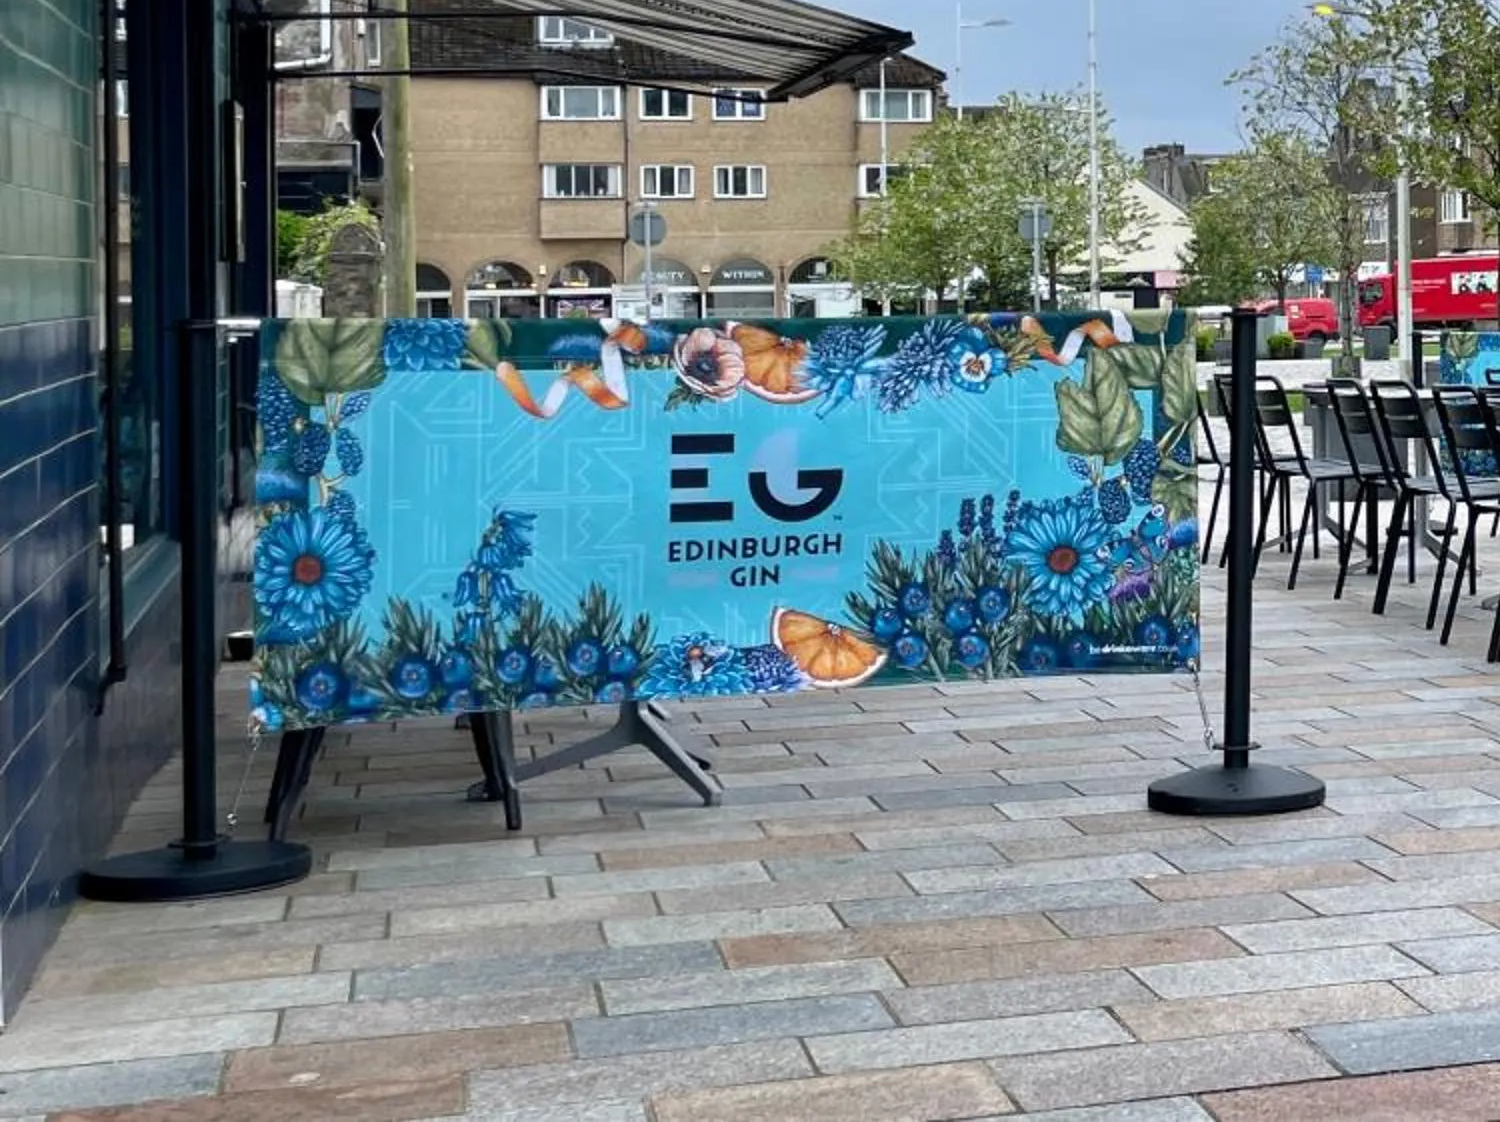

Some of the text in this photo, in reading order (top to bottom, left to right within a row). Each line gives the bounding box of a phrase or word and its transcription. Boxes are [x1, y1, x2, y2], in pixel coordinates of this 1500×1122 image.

[669, 431, 844, 523] EG
[668, 533, 843, 563] EDINBURGH
[729, 564, 780, 588] GIN
